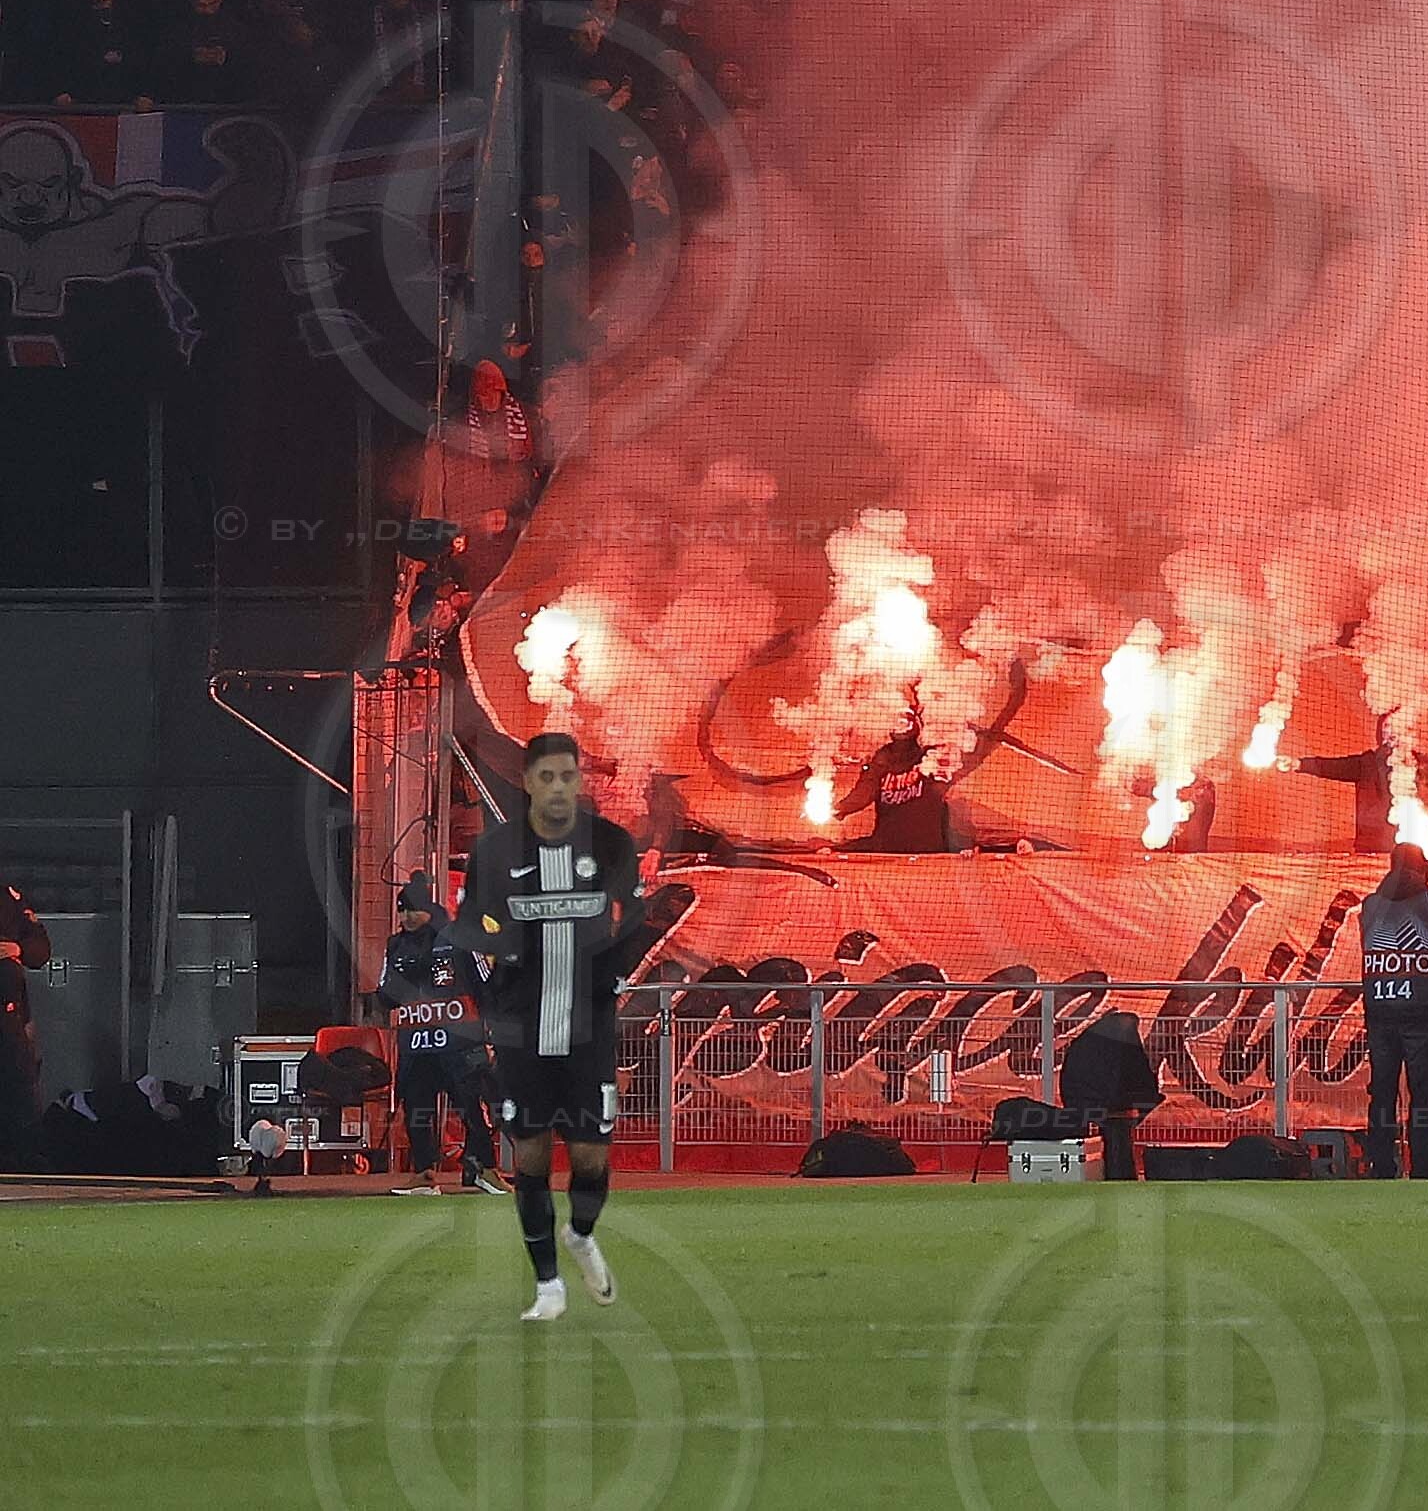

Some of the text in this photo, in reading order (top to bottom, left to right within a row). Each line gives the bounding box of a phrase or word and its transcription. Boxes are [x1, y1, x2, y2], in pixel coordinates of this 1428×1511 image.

[1373, 979, 1412, 1000] 114
[399, 999, 464, 1026] PHOTO
[410, 1028, 449, 1050] 019
